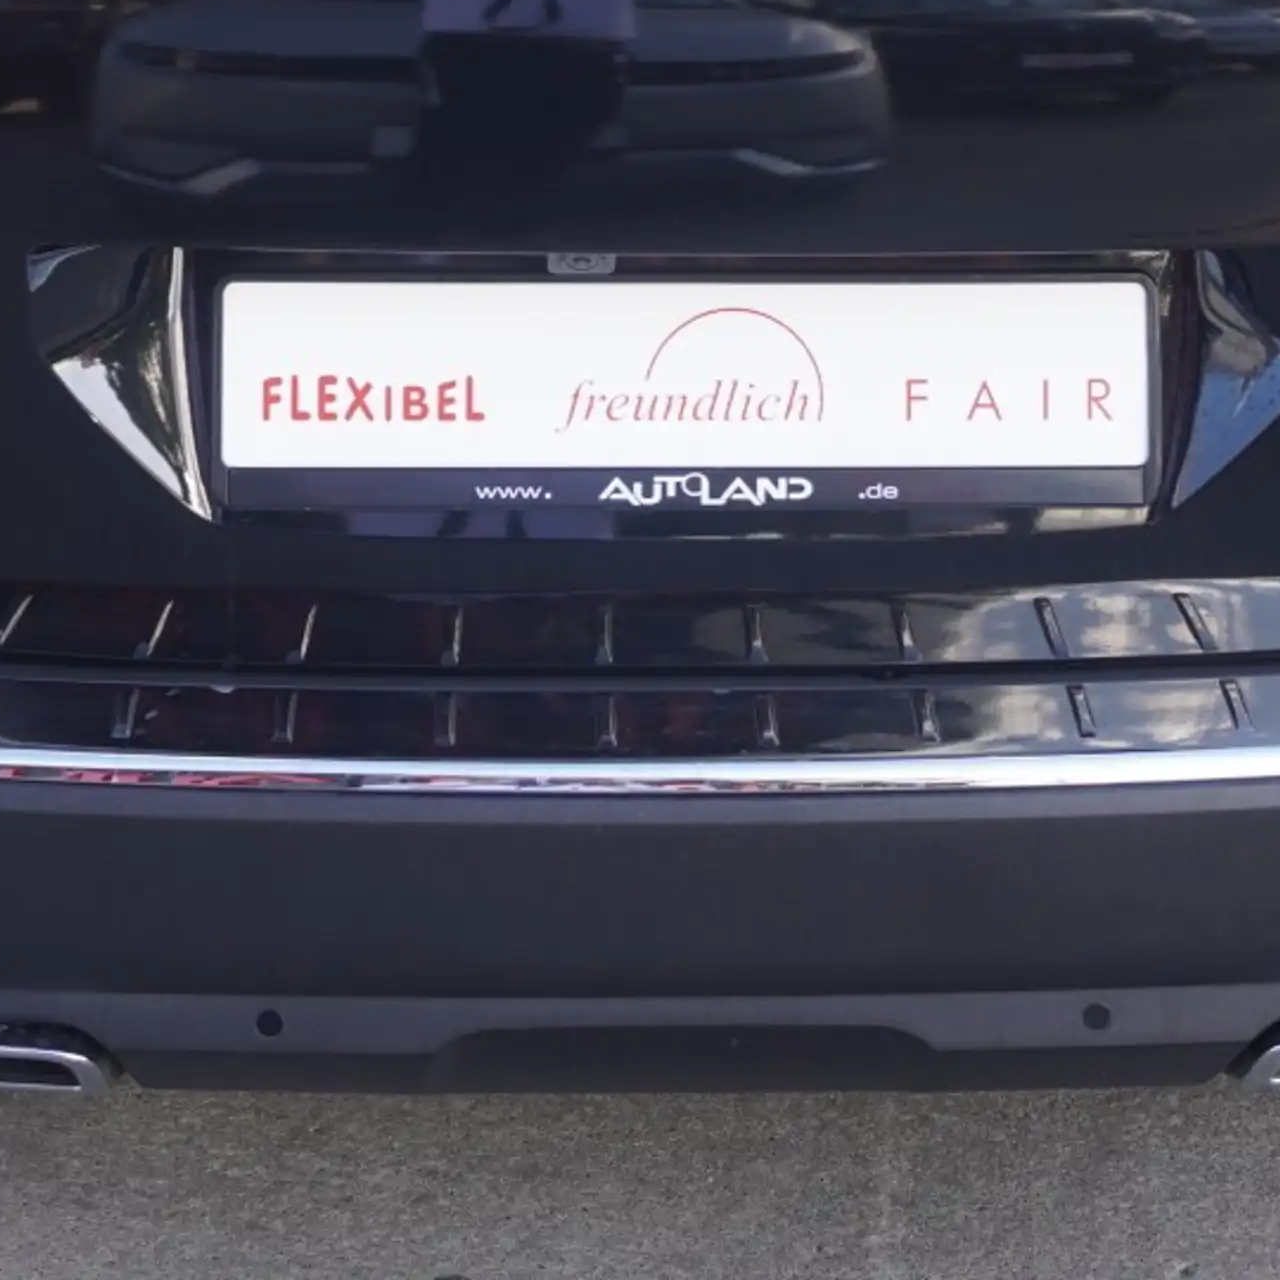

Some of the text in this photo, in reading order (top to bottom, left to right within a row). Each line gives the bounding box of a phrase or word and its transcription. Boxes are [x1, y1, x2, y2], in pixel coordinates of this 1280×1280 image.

[261, 374, 1115, 435] FLEXIBEL freundlich FAIR
[473, 471, 900, 507] www. AUTOLAND .de
